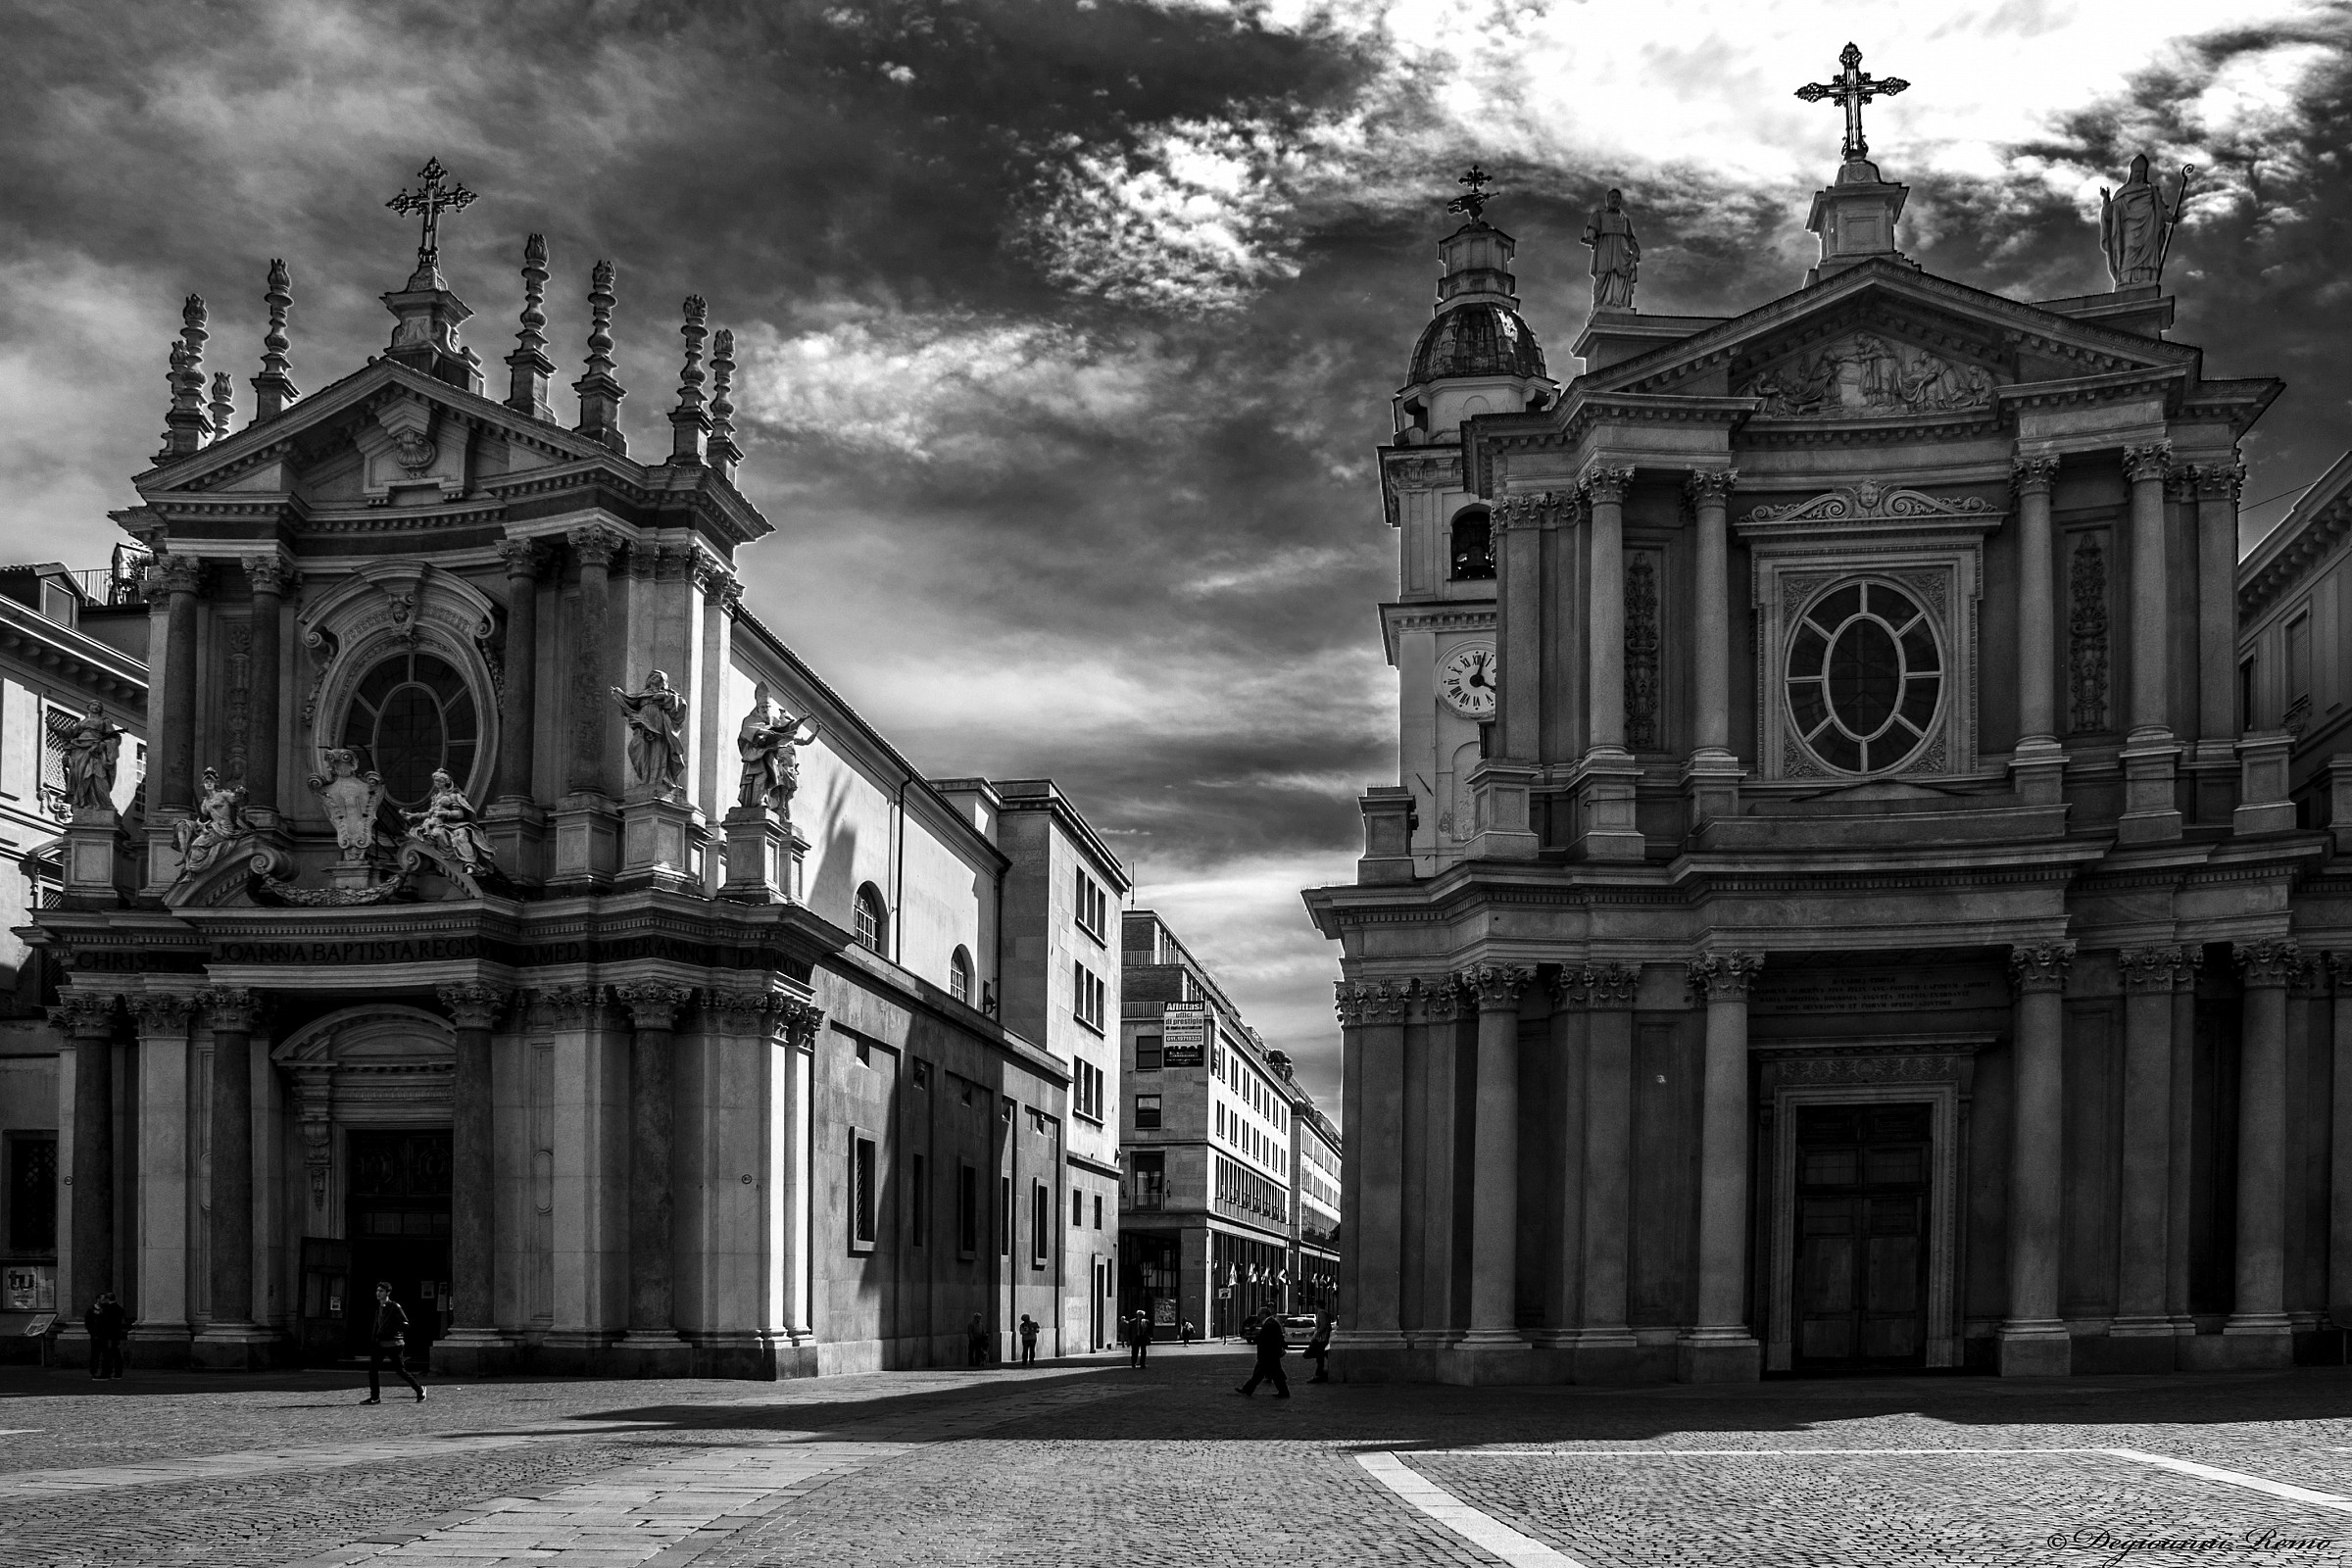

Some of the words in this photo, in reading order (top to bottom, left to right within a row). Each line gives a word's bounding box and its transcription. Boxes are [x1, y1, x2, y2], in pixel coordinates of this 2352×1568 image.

[214, 944, 307, 961] JOANNA
[313, 941, 415, 960] BAPTISTA
[418, 938, 476, 958] REGIS
[590, 937, 653, 964] MATER
